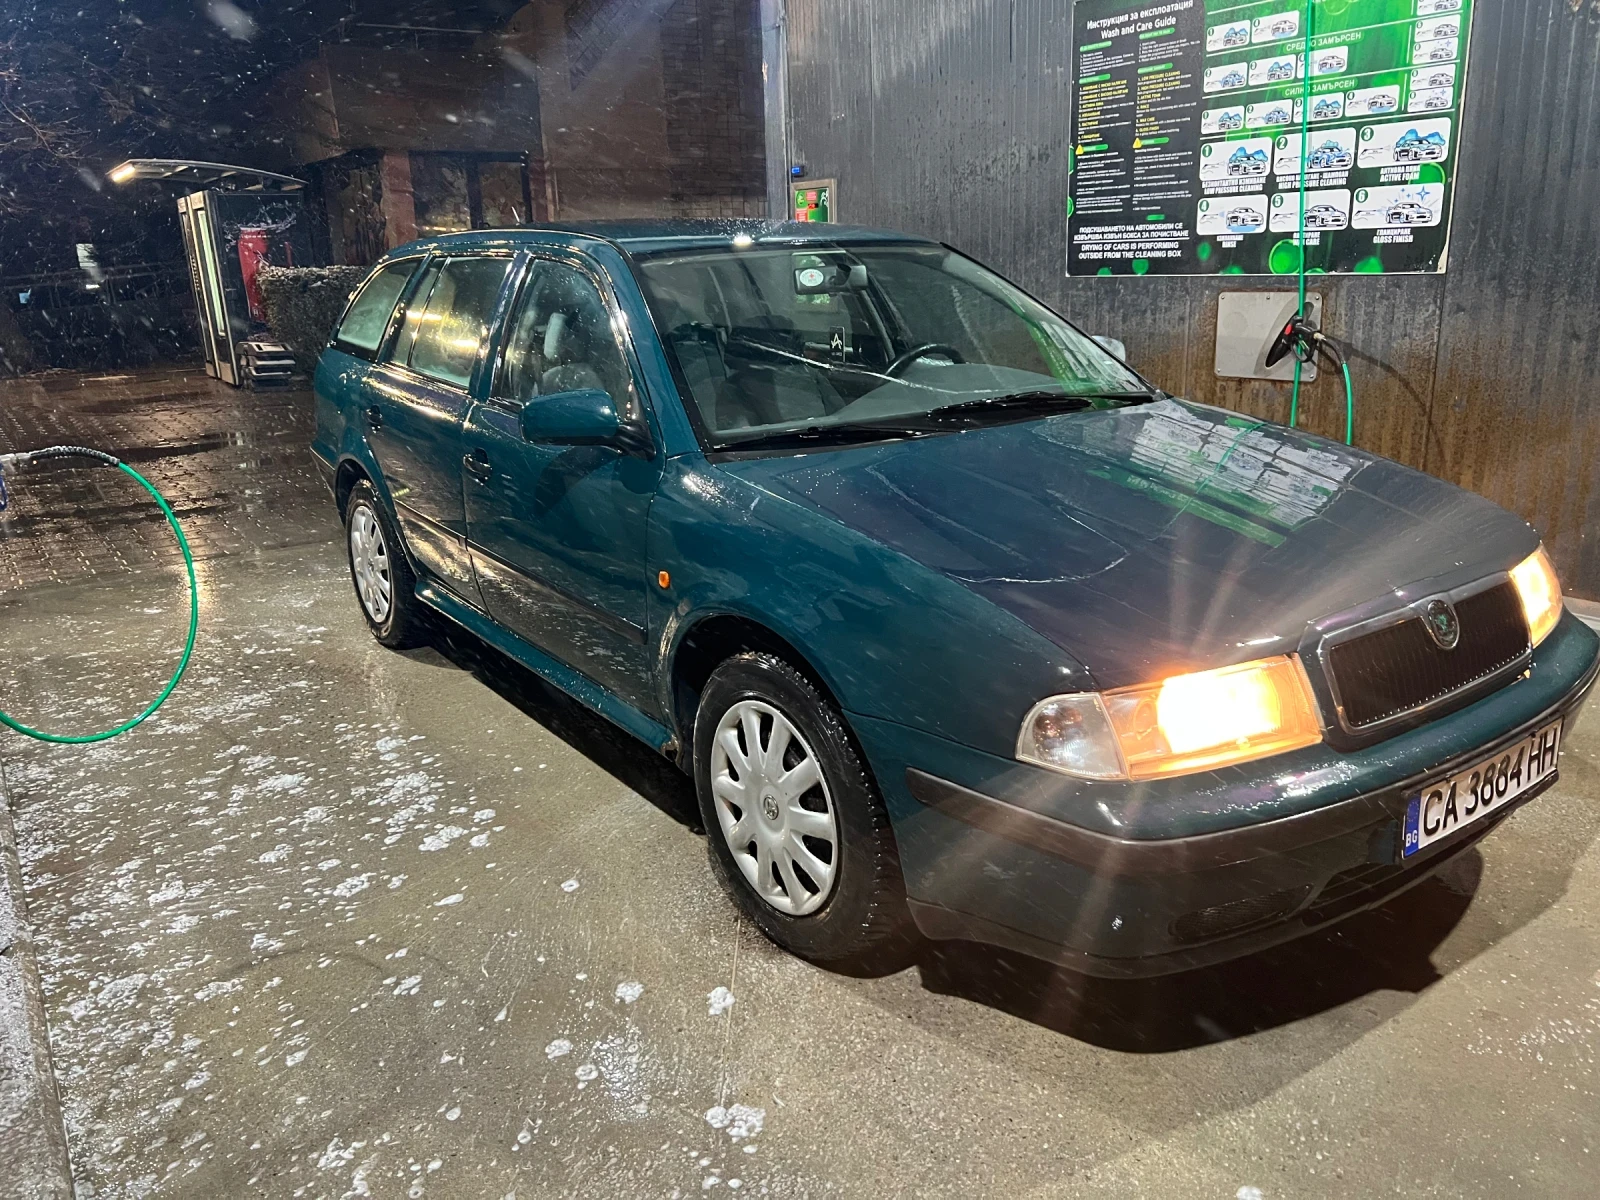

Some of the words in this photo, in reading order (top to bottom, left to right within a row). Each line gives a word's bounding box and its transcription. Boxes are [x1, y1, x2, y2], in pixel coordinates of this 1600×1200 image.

[1087, 14, 1128, 30] Инструкция
[1140, 0, 1193, 17] експлоатация
[1101, 28, 1120, 39] Wash
[1121, 24, 1135, 35] and
[1136, 22, 1153, 32] Care
[1155, 16, 1176, 27] Guide
[1286, 41, 1316, 51] СРЕДО
[1318, 32, 1362, 44] ЗАМЪРСЕН
[1313, 80, 1355, 92] ЗАМЪРСЕН
[1380, 174, 1401, 182] ACTIVE
[1402, 172, 1420, 181] FOAM
[1406, 830, 1418, 847] BG
